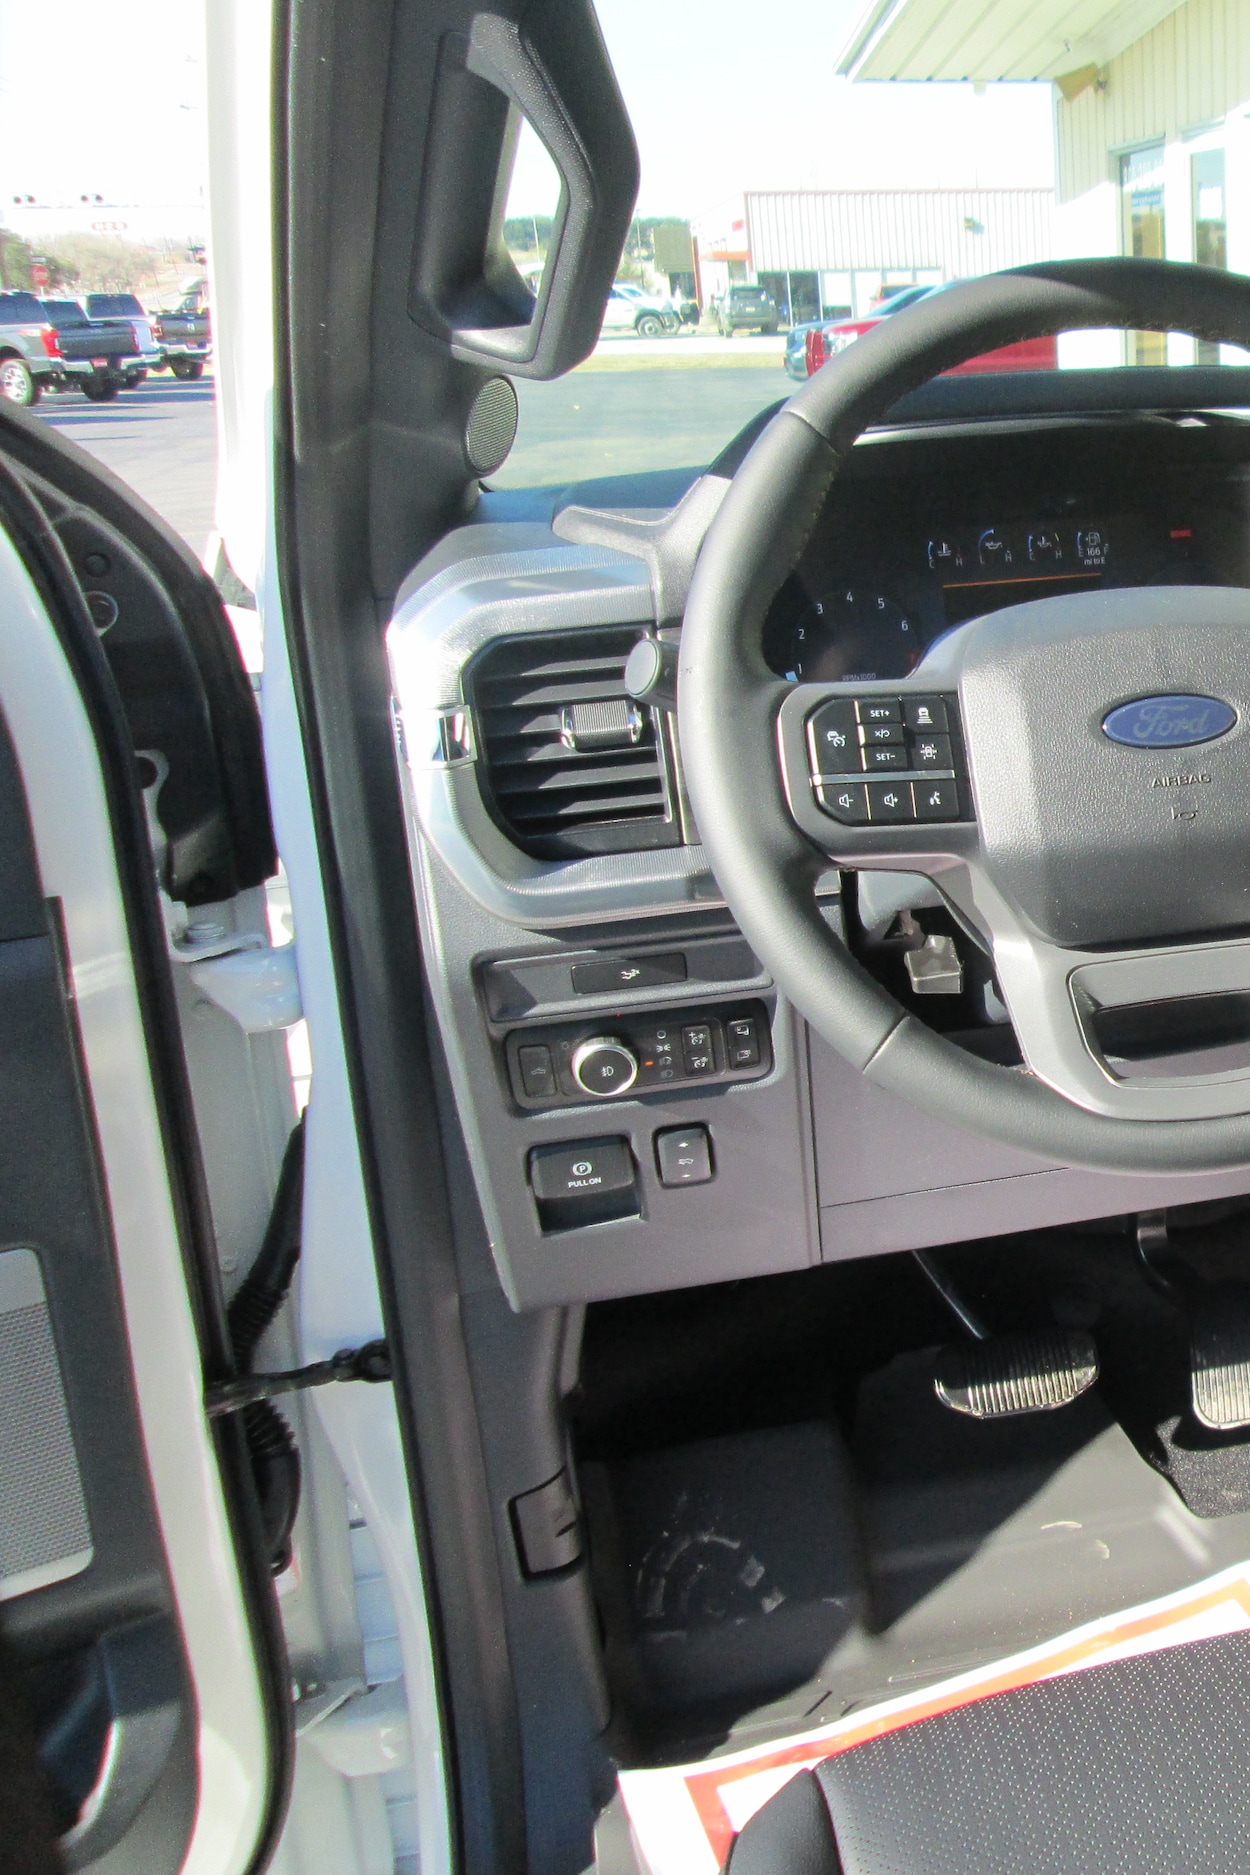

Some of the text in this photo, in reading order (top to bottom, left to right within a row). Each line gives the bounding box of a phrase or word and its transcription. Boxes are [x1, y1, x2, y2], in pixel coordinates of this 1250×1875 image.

[1086, 547, 1101, 556] 166
[846, 591, 853, 602] 4
[816, 603, 823, 614] 3
[878, 598, 885, 609] 5
[901, 620, 908, 631] 6
[799, 628, 805, 639] 2
[870, 709, 890, 718] SET+
[1133, 704, 1210, 738] Ford
[1152, 774, 1212, 788] AIRBAG
[568, 1177, 602, 1188] PULL ON
